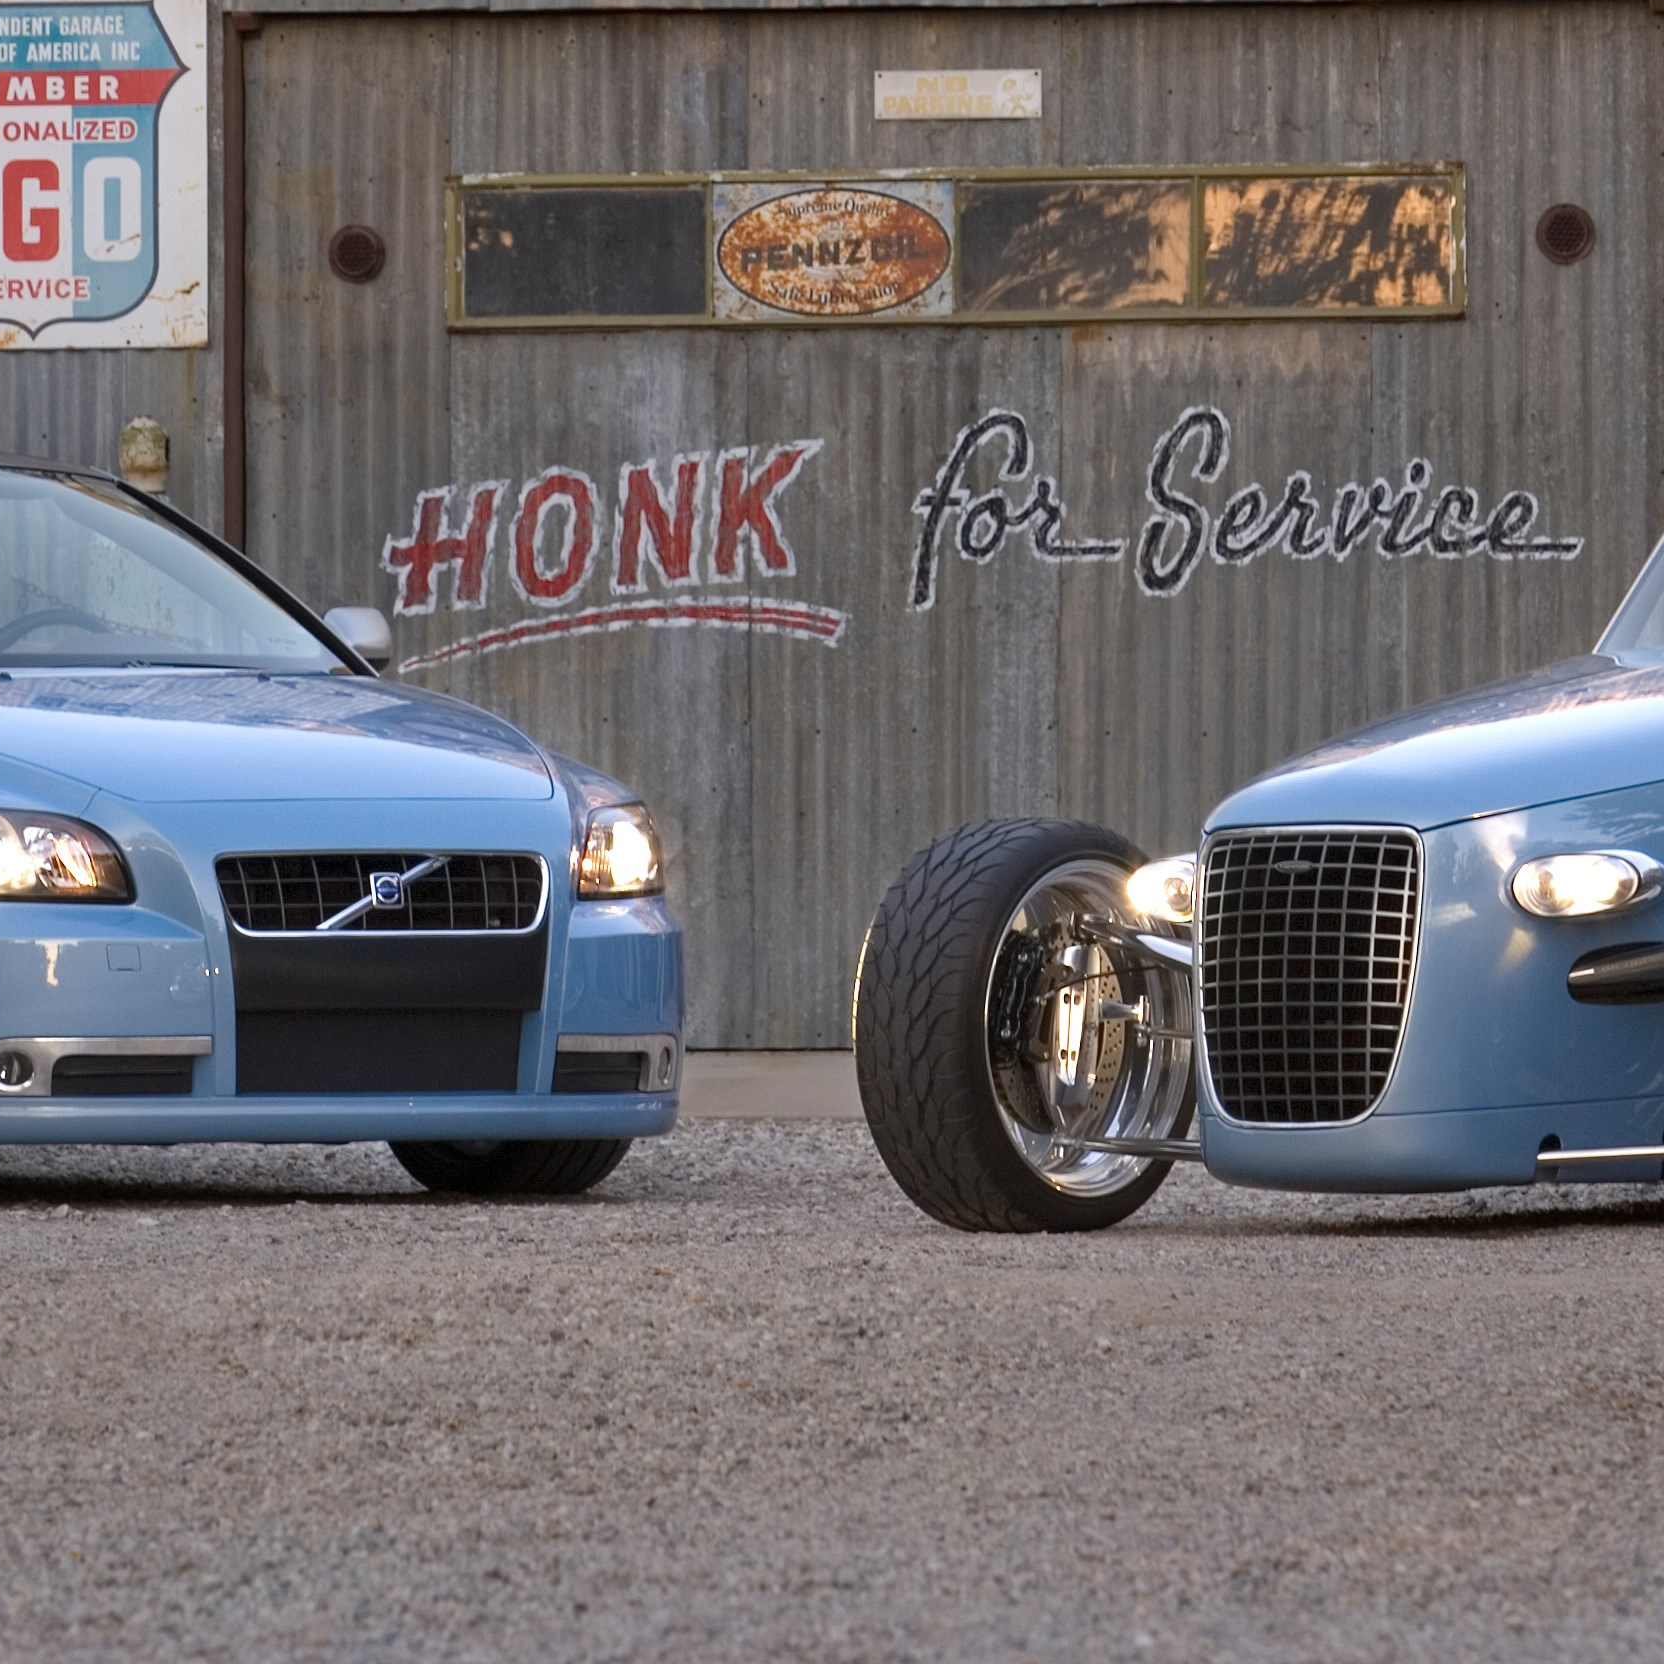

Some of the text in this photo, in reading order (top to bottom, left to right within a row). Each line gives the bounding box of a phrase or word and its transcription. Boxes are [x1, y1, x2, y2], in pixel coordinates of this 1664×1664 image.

[59, 15, 124, 36] GARAGE
[26, 41, 101, 63] AMERICA
[111, 41, 140, 62] INC
[916, 75, 968, 93] NO
[883, 95, 994, 114] PARKING
[740, 233, 928, 273] PENNZOIL
[769, 282, 803, 302] Safe
[381, 404, 1584, 618] HONK for Service
